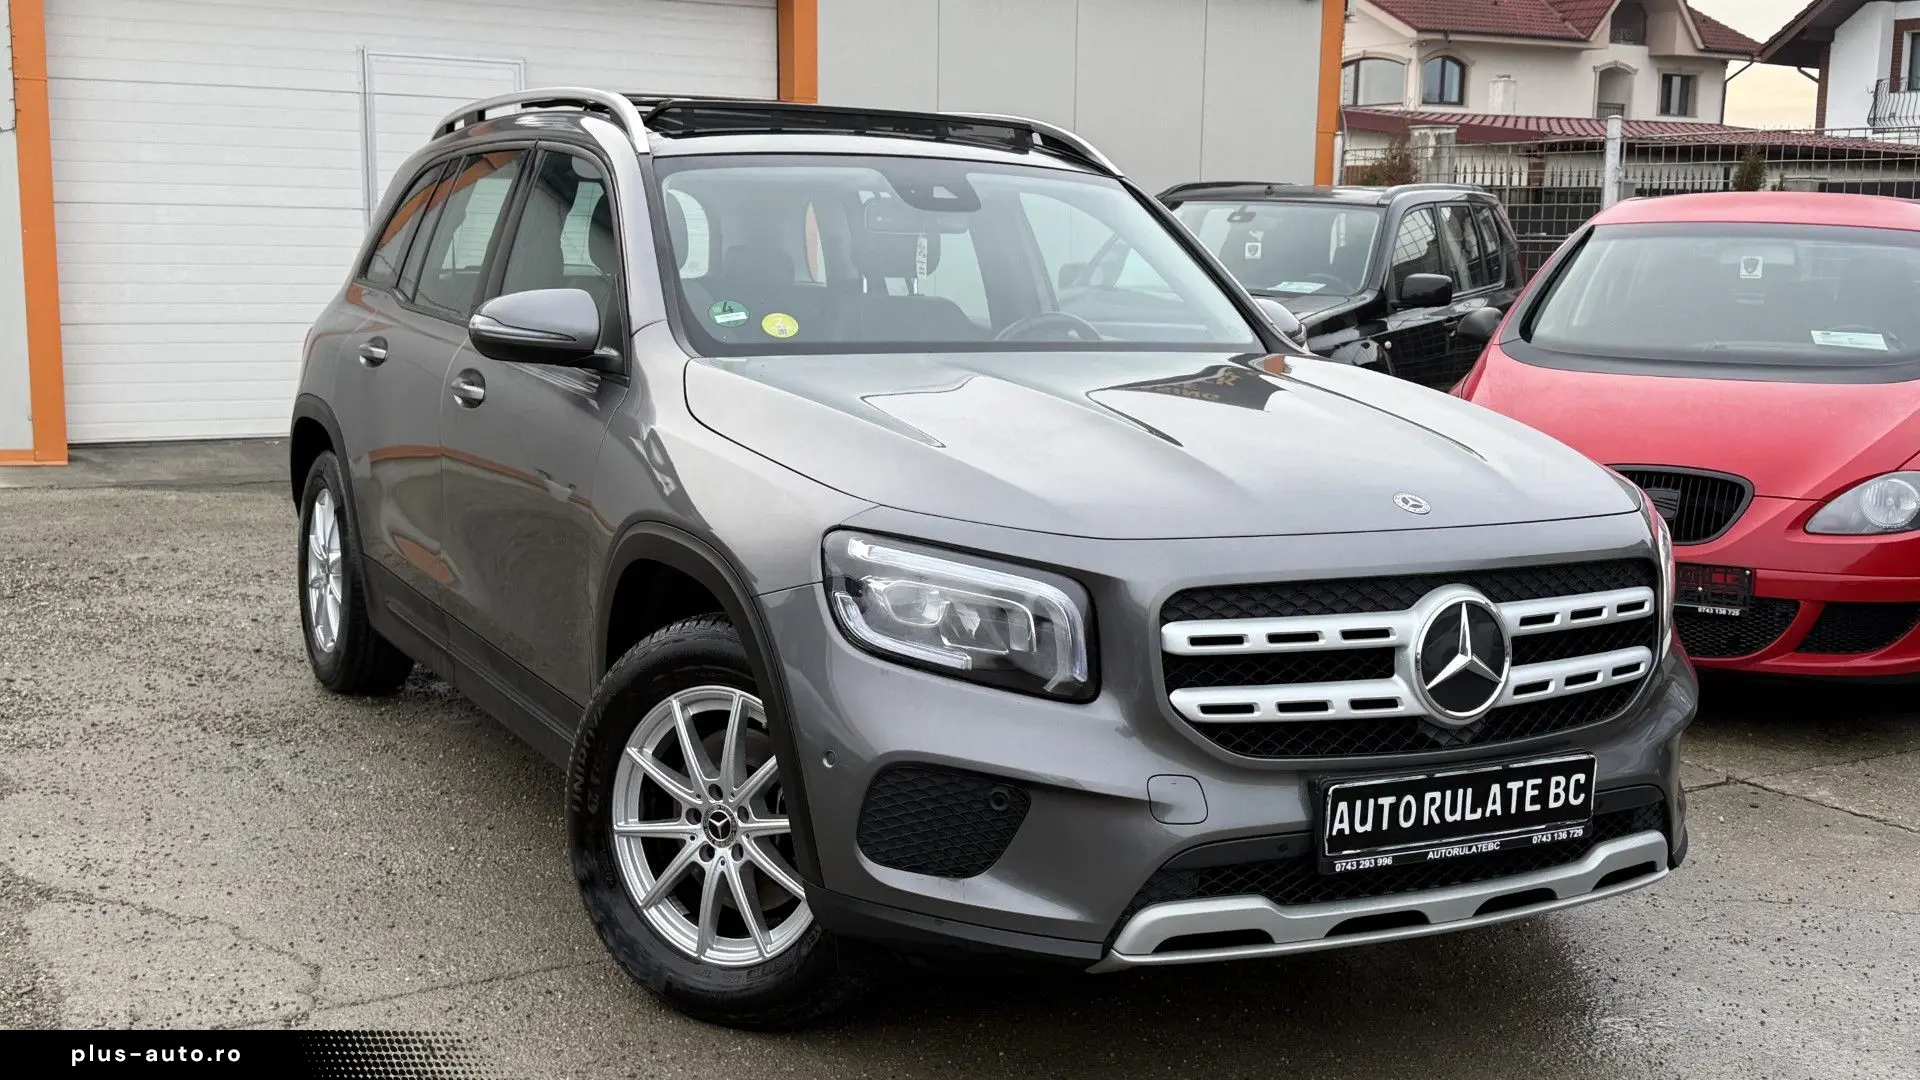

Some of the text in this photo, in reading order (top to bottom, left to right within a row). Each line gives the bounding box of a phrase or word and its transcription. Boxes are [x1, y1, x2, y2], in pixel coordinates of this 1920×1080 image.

[1549, 774, 1586, 809] BC
[1335, 829, 1584, 872] 0743 293 996 AUTORULATEBC 0743 136 729
